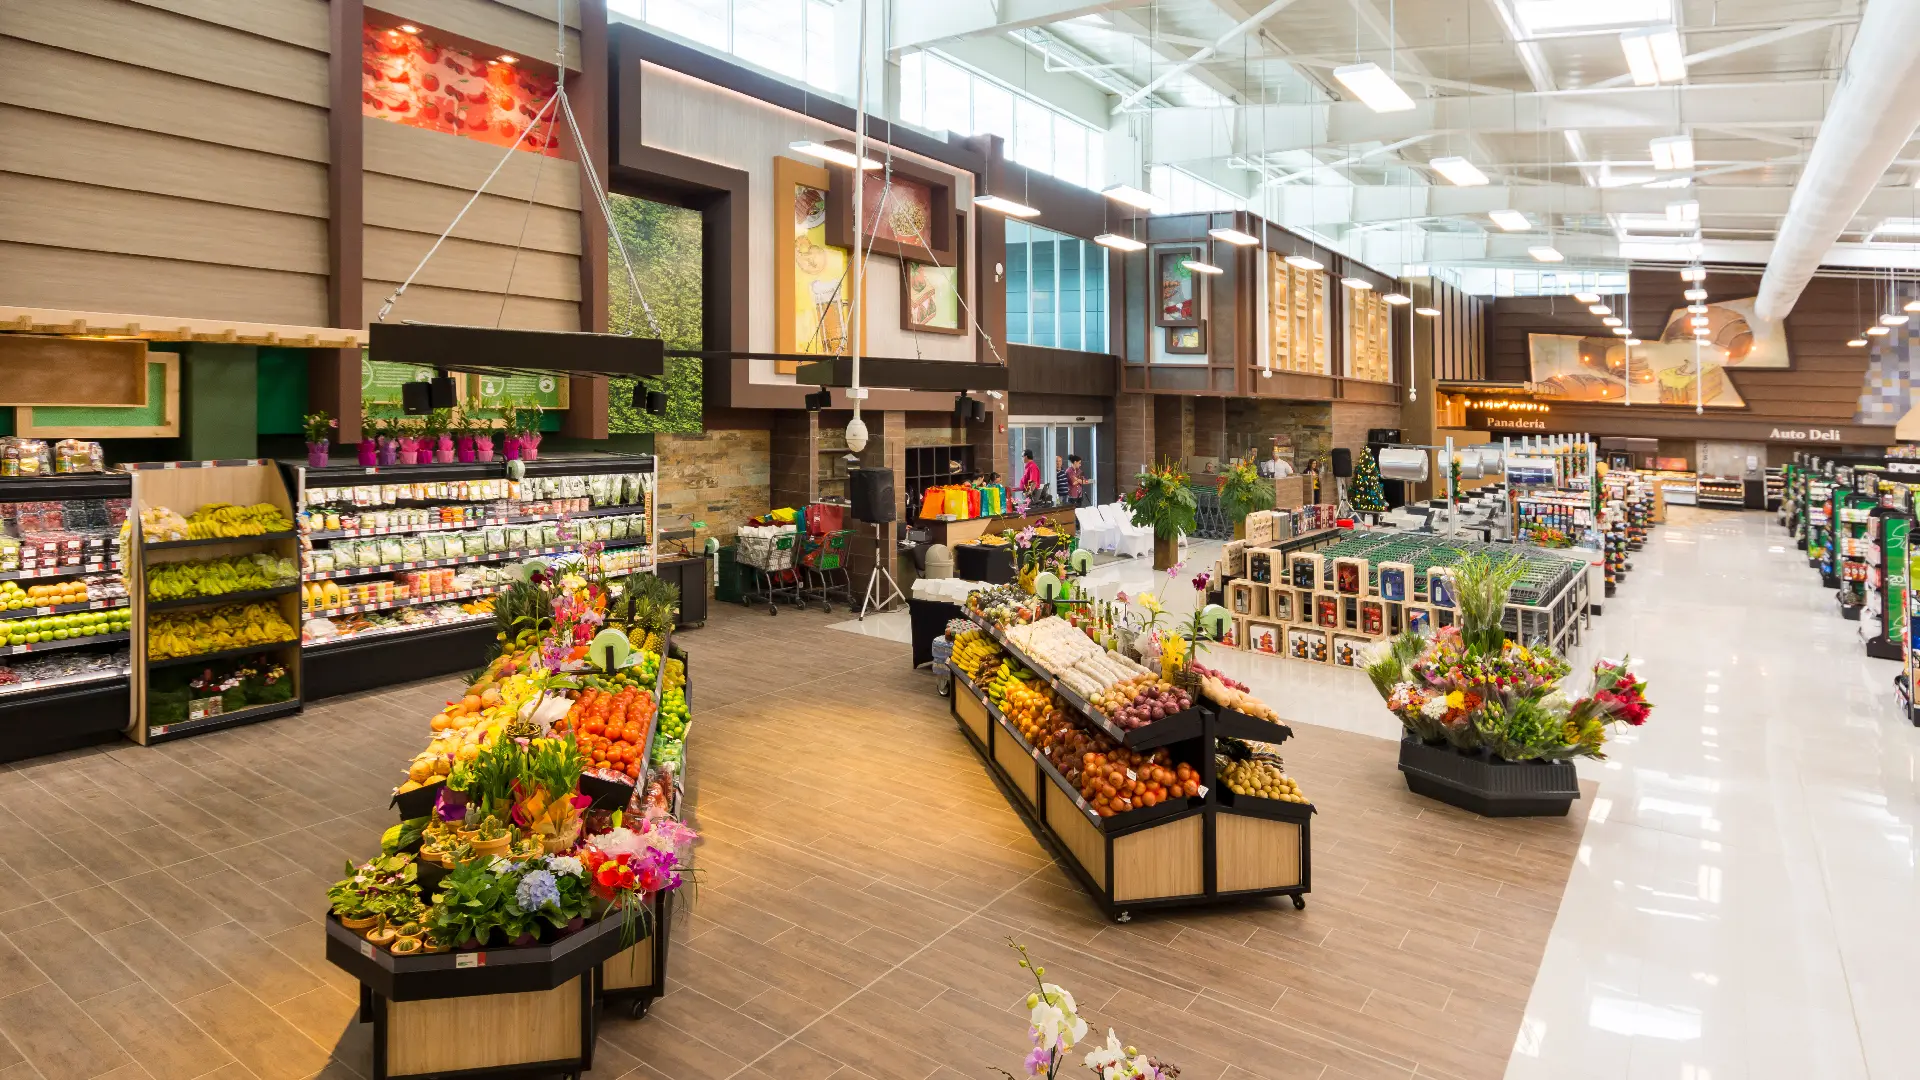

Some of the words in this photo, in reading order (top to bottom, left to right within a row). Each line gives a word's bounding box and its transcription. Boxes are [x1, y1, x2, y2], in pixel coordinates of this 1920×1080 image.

[1487, 417, 1546, 429] Panadería
[1769, 428, 1806, 440] Auto
[1809, 429, 1841, 441] Deli
